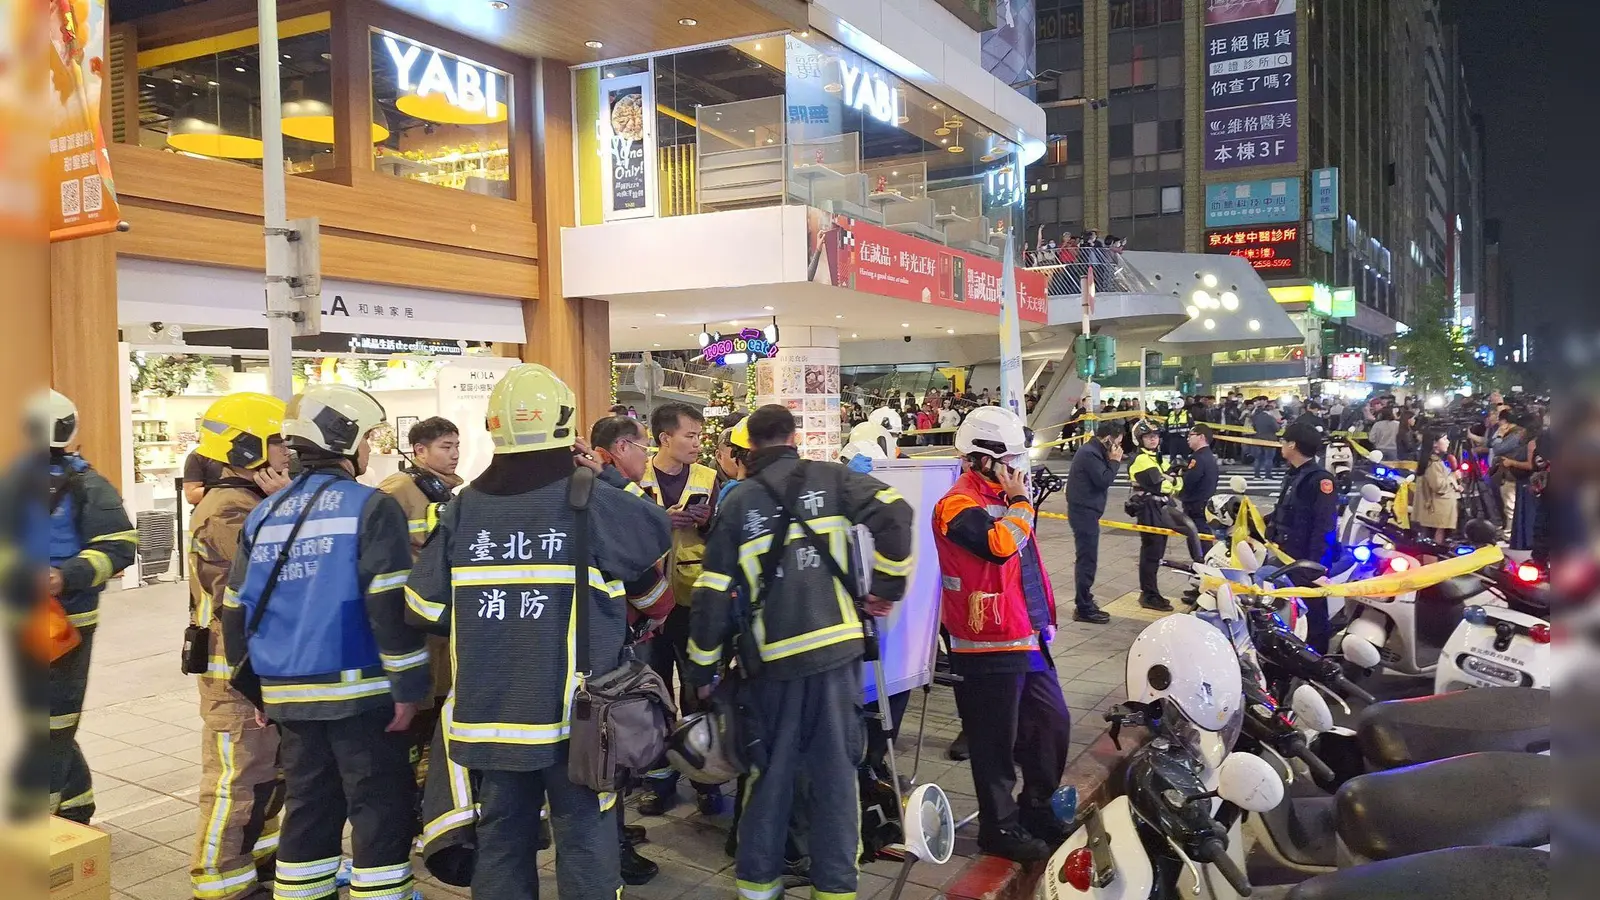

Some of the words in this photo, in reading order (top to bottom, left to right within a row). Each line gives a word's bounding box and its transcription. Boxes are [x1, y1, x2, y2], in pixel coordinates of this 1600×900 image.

[1210, 29, 1291, 56] 拒絕假貨
[382, 35, 498, 118] YABI
[1213, 57, 1269, 74] 認證診所
[840, 60, 898, 127] YABI
[1227, 112, 1291, 134] 維格醫美
[615, 161, 644, 180] Only!
[734, 337, 747, 352] to
[470, 372, 495, 380] HOLA
[516, 408, 544, 422] 三大
[469, 528, 567, 562] 臺北市
[477, 590, 549, 621] 消防
